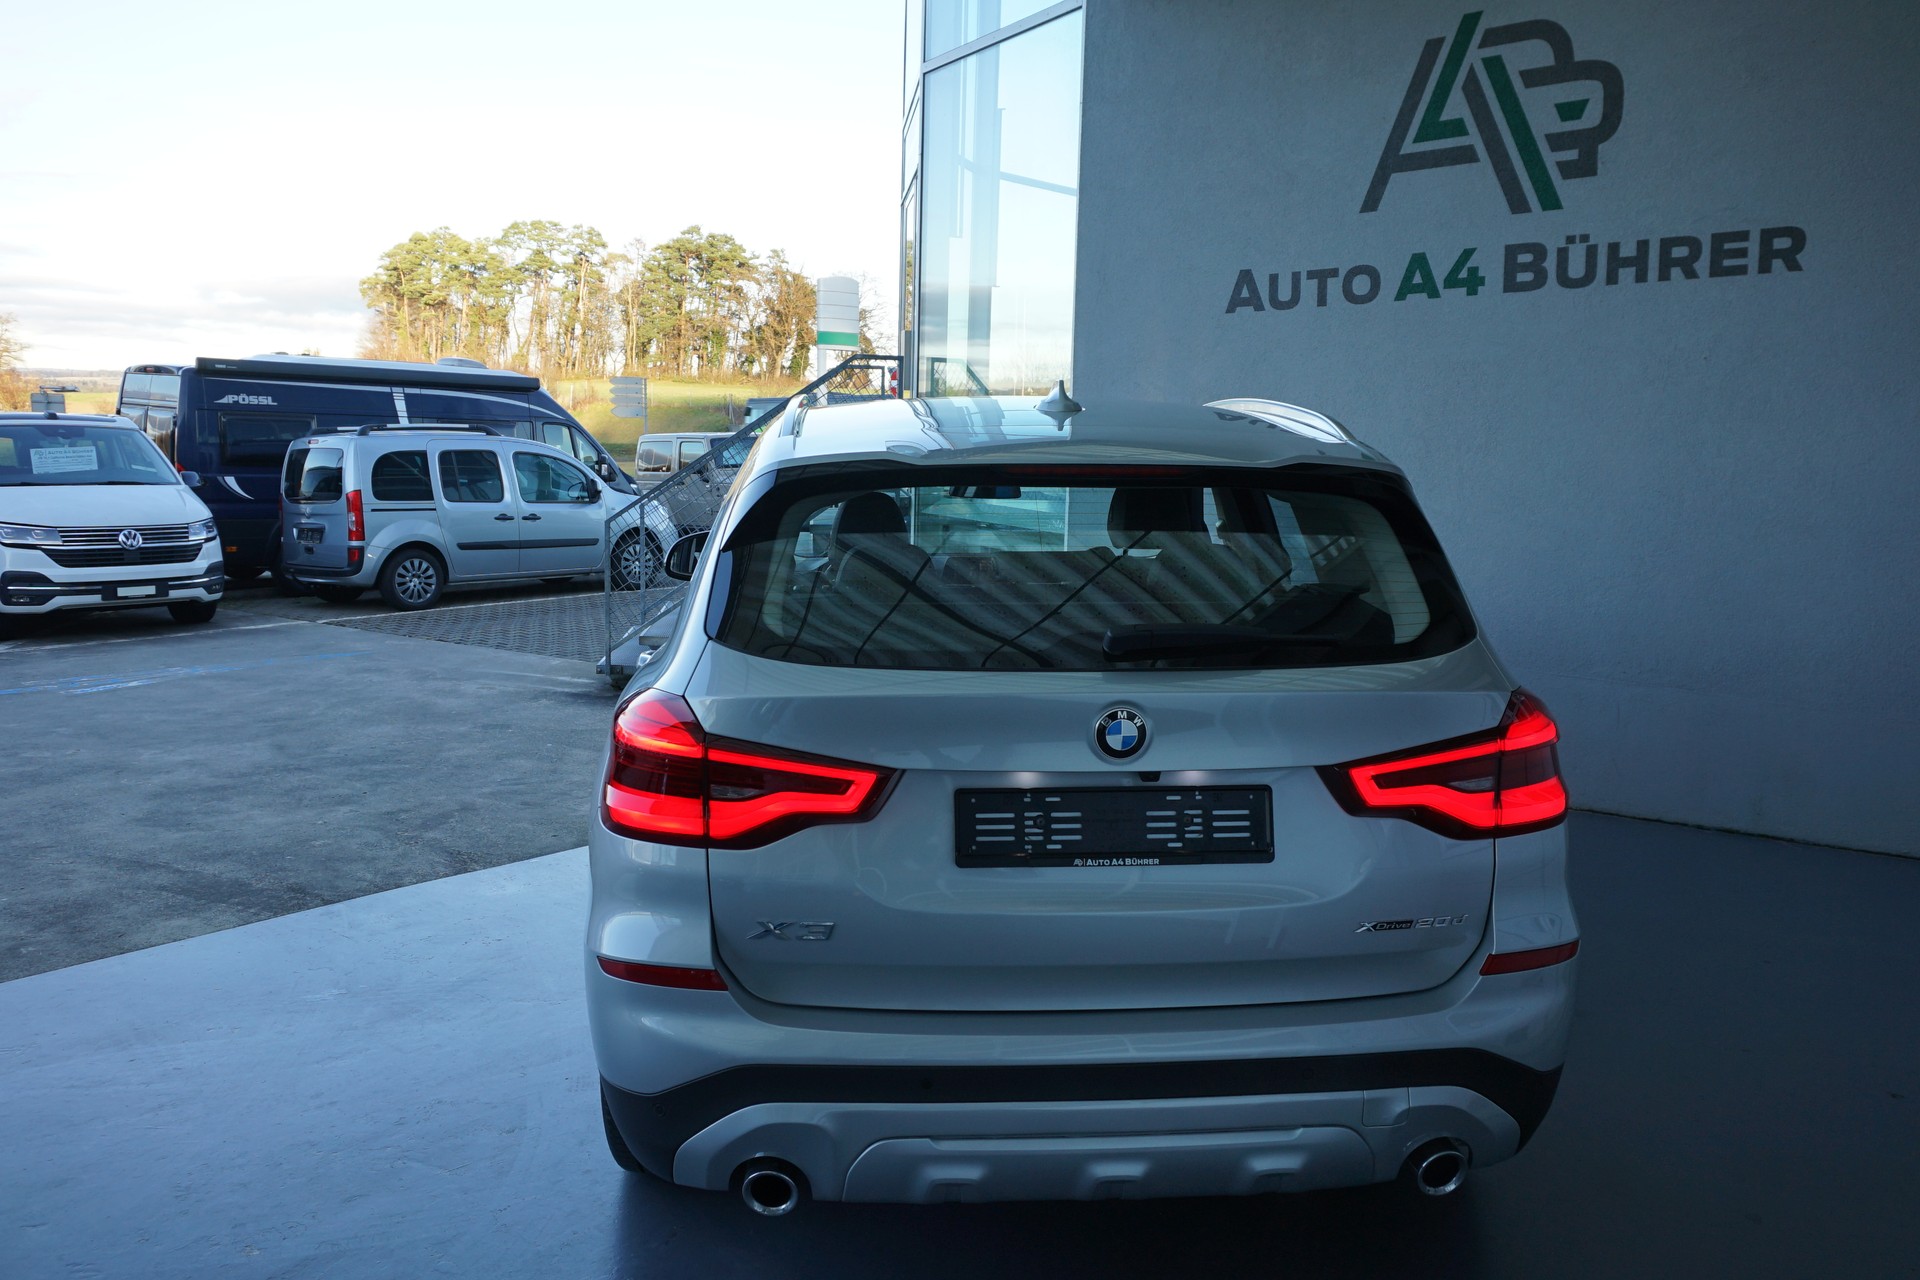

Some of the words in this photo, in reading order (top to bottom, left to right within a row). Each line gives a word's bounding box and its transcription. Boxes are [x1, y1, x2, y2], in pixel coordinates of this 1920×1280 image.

[1225, 264, 1382, 315] AUTO
[1394, 247, 1486, 303] A4
[1502, 226, 1808, 295] BÜHRER
[227, 393, 278, 405] PÖSSL
[1101, 710, 1143, 727] BMW
[1086, 858, 1110, 866] AUTO
[1111, 858, 1124, 866] A4
[1125, 857, 1160, 866] BÜHRER
[1414, 914, 1468, 929] 20d
[746, 921, 835, 940] X3
